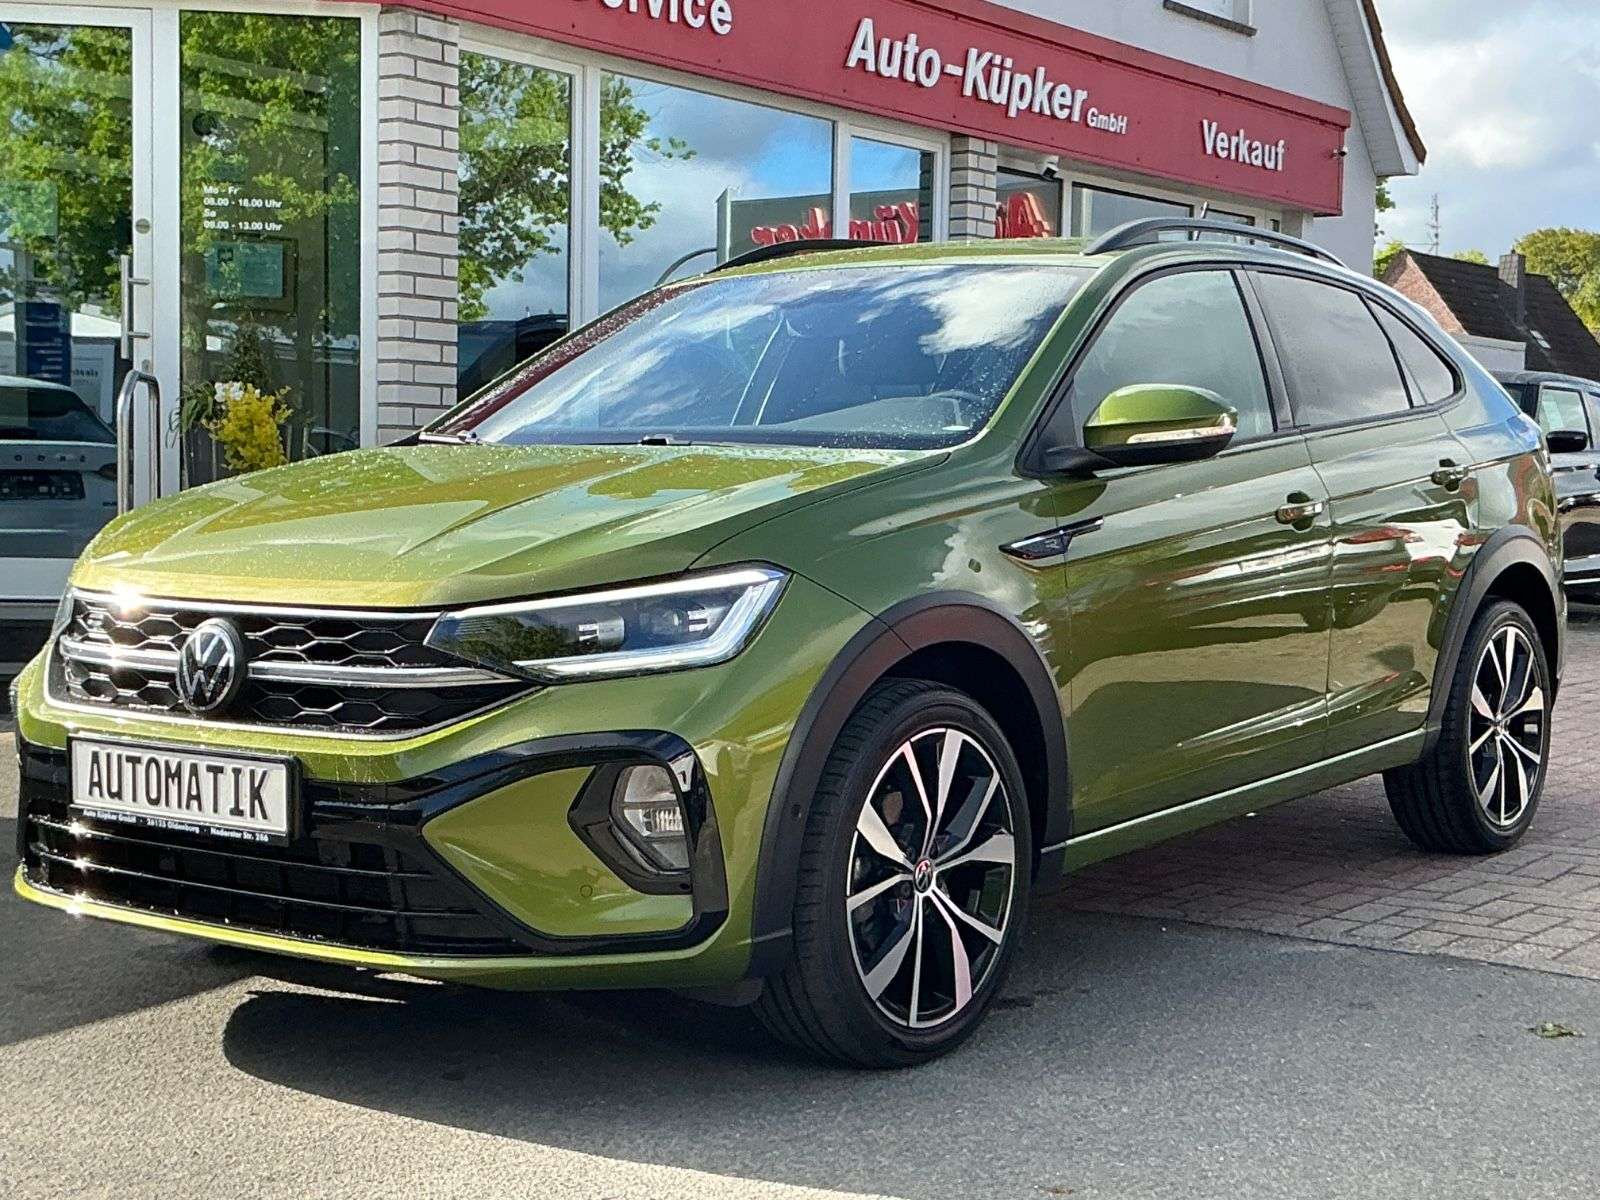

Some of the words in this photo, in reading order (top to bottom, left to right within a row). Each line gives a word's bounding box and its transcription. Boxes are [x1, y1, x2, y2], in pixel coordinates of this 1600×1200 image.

[602, 0, 733, 35] vice
[846, 17, 1088, 122] Auto-Küpker
[1086, 107, 1128, 134] GmbH
[1202, 119, 1285, 171] Verkauf
[265, 200, 282, 208] Uhr
[265, 223, 282, 231] Uhr
[88, 750, 268, 820] AUTOMATIK
